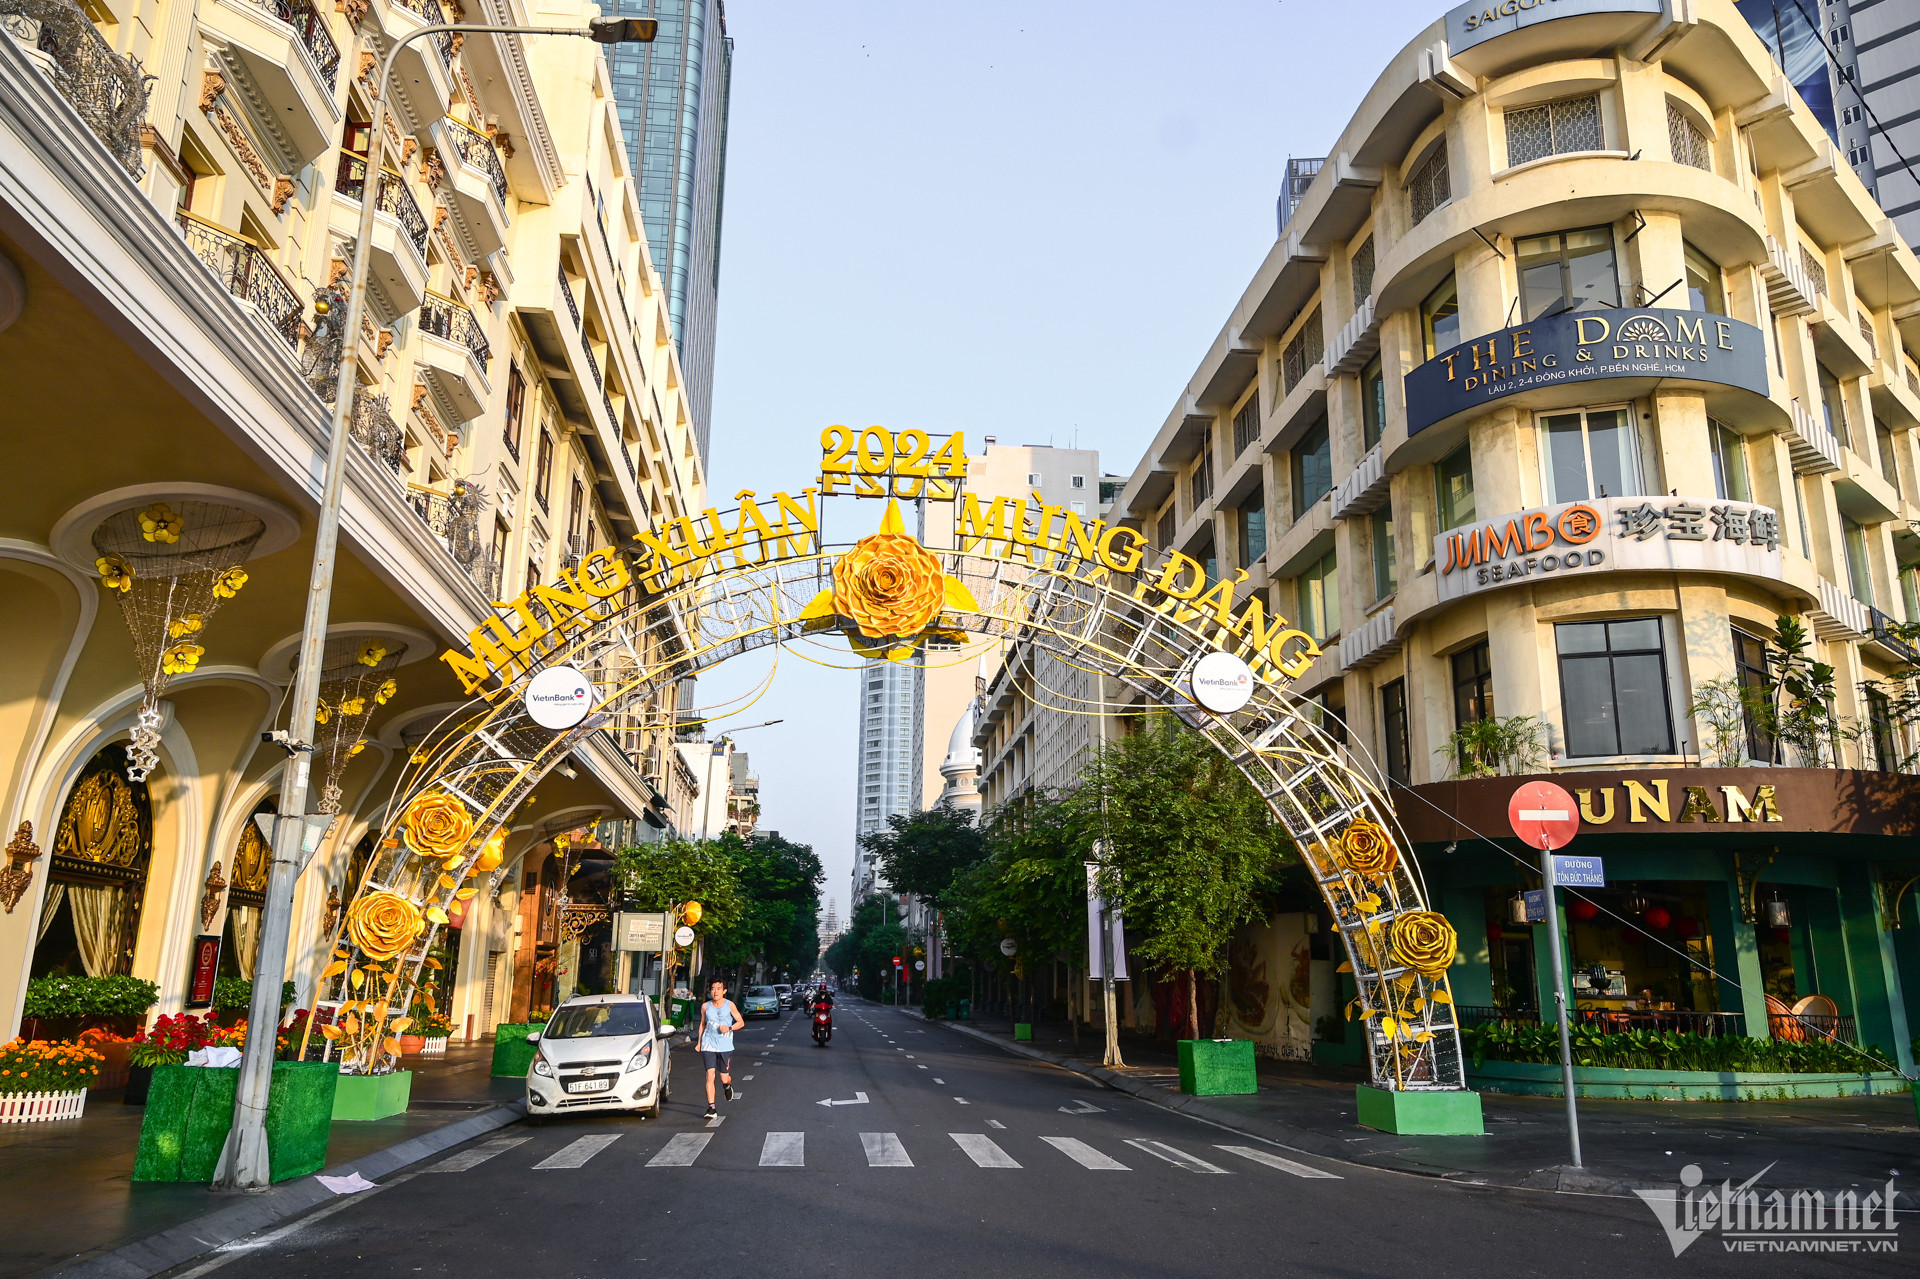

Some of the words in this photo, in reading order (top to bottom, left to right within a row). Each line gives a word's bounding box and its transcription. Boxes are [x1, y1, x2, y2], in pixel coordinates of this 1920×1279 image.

[1466, 0, 1557, 31] SAIGO
[1440, 329, 1535, 381] THE
[1465, 354, 1557, 391] DINING
[1576, 348, 1594, 362] &
[1613, 344, 1708, 363] DRINKS
[1508, 381, 1517, 390] 2,
[1518, 376, 1533, 387] 2-4
[1665, 364, 1685, 373] HCM
[820, 424, 970, 478] 2024
[1442, 505, 1602, 575] JUMBO
[955, 490, 1149, 573] MỪNG
[1154, 549, 1324, 679] ĐẢNG
[1477, 549, 1606, 585] SEAFOOD
[439, 546, 631, 695] MỪNG
[632, 487, 818, 580] XUÂN
[532, 694, 574, 702] VietinBank
[1199, 678, 1238, 686] VietinBank
[1564, 859, 1593, 869] ĐƯỜNG
[1570, 871, 1582, 883] ĐỨC
